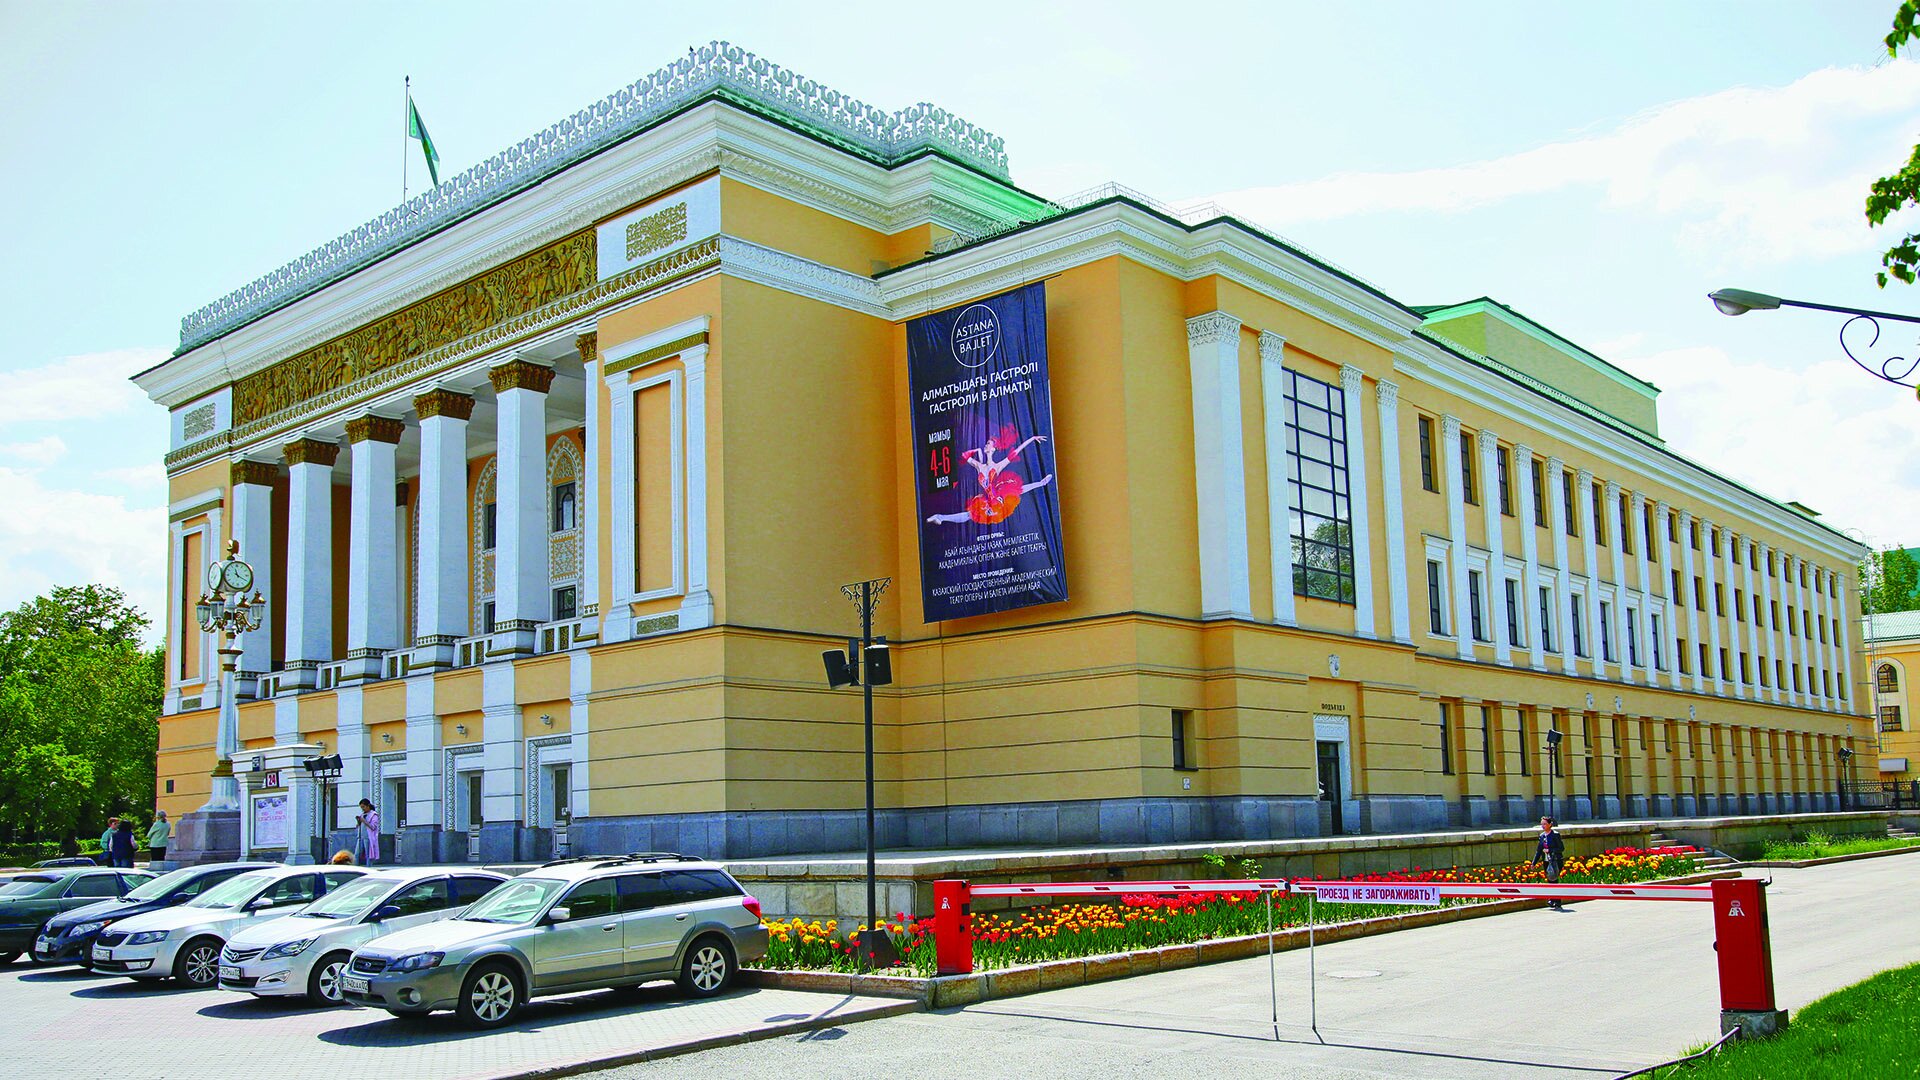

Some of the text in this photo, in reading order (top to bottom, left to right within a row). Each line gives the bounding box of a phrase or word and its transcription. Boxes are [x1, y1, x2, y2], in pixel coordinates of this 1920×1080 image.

[956, 319, 994, 339] ASTANA
[959, 335, 992, 354] BALLET
[922, 362, 1038, 402] АЛМАТЫДАҒЫ ГАСТРОЛІ
[929, 379, 1032, 414] ГАСТРОЛИ В АЛМАТЫ
[929, 428, 951, 444] мамыр
[930, 446, 951, 477] 4-6
[936, 475, 949, 488] мая
[944, 548, 958, 558] АБАЙ
[978, 553, 994, 564] ОПЕРА
[1011, 546, 1027, 556] БАЛЕТ
[1027, 542, 1047, 553] ТЕАТРЫ
[932, 566, 1057, 597] КАЗАХСКИЙ ГОСУДАРСТВЕННЫЙ АКАДЕМИЧЕСКИЙ
[949, 581, 1041, 605] ТЕАТР ОПЕРЫ И БАЛЕТА ИМЕНИ АБАЯ
[268, 774, 276, 785] 24
[1318, 888, 1349, 900] ПРОЕЗД
[1353, 889, 1362, 899] НЕ
